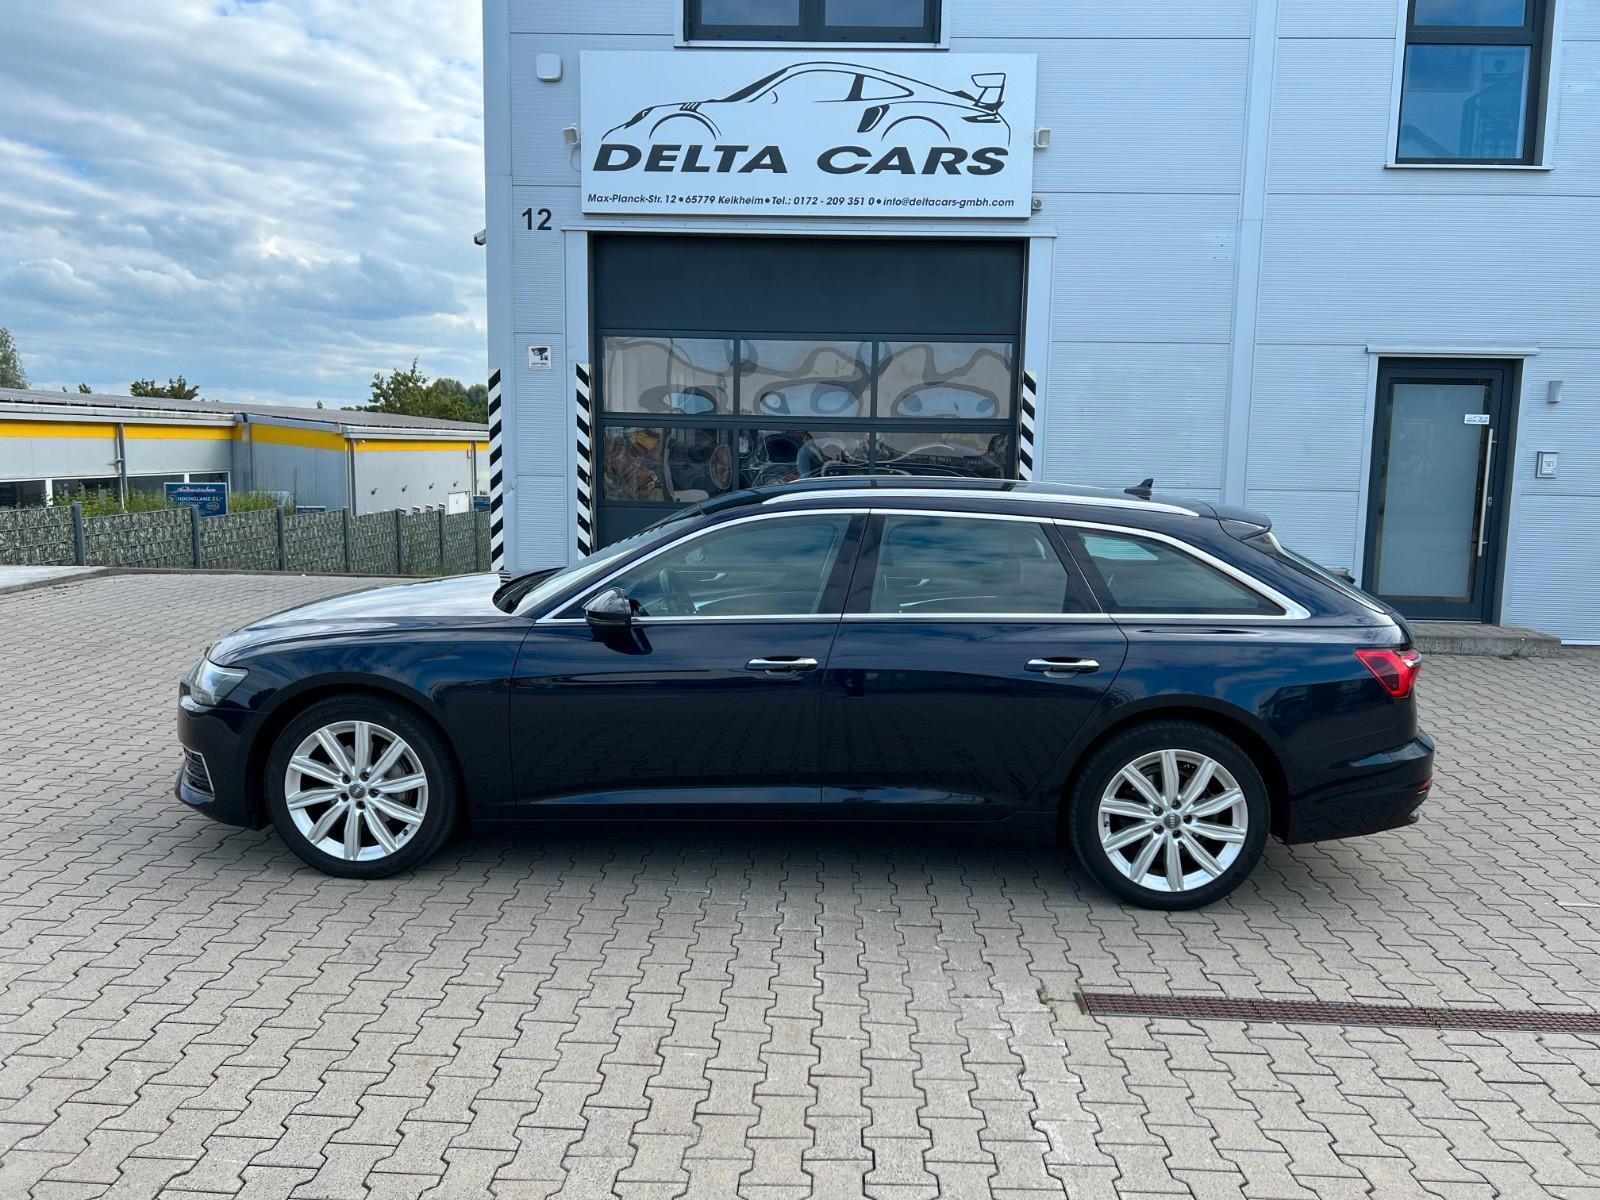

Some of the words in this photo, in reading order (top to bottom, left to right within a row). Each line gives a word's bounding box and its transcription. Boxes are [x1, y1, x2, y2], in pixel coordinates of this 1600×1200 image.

[592, 143, 788, 173] DELTA
[816, 145, 1009, 175] CARS
[665, 194, 677, 203] 12
[793, 196, 818, 205] 0172
[826, 196, 845, 206] 209
[847, 196, 864, 206] 351
[868, 196, 875, 206] 0
[883, 197, 1015, 208] info@deltacars-gmbh.com
[522, 207, 552, 231] 12
